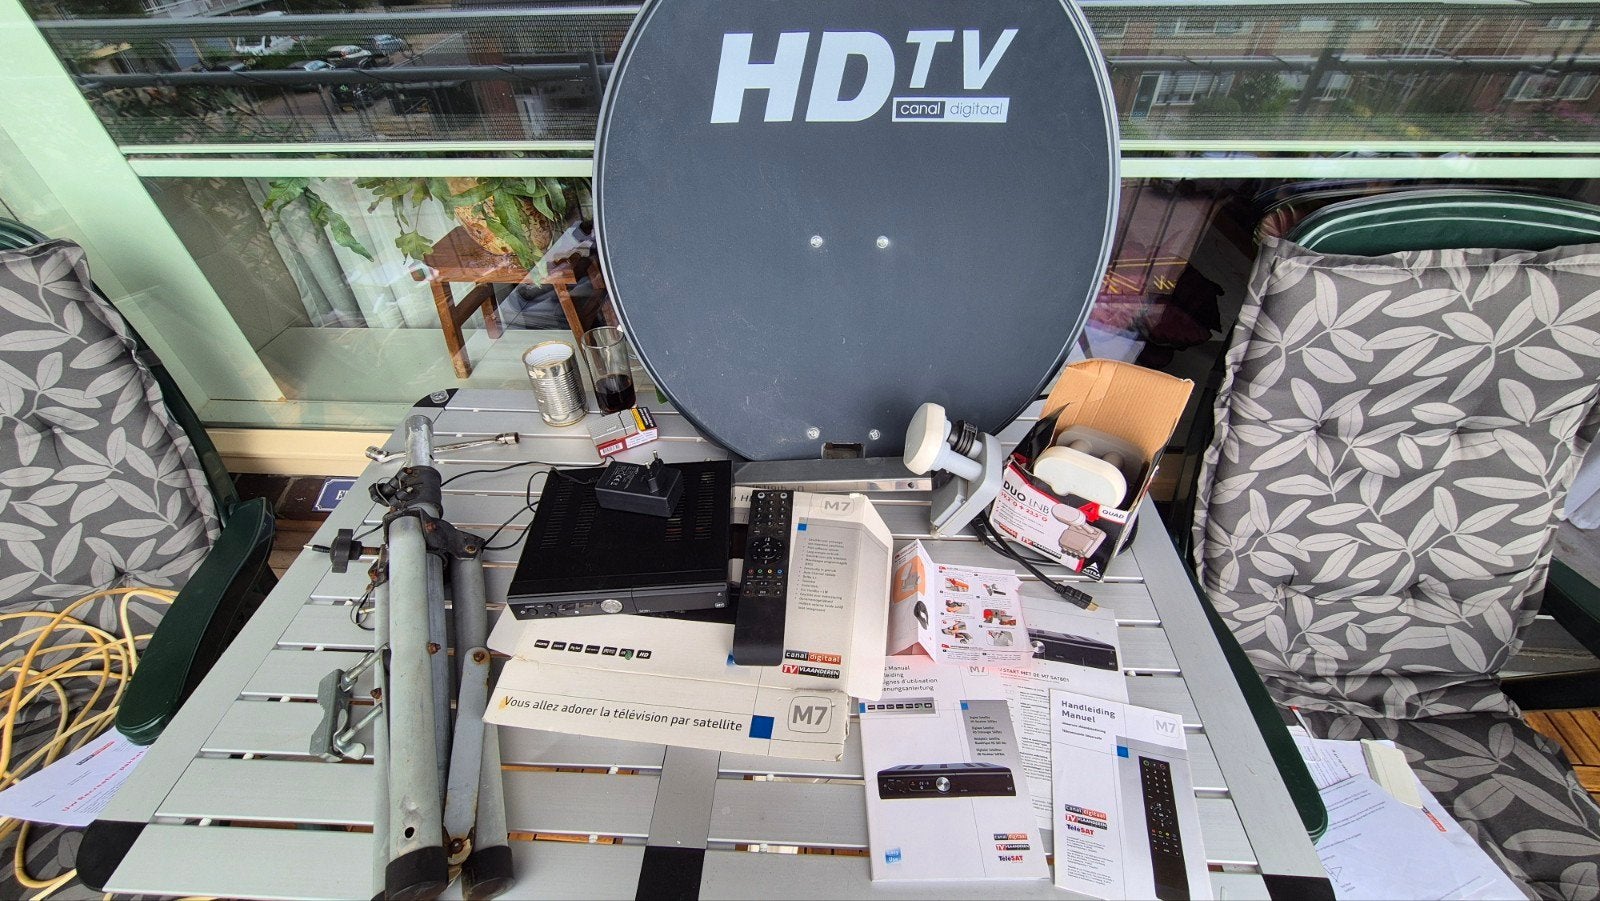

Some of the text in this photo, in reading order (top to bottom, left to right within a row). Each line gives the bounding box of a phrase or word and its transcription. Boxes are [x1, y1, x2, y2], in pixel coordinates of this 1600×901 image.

[900, 100, 1003, 118] canal digitaal
[1002, 480, 1050, 514] DUO LNB
[824, 501, 851, 512] M7
[1102, 509, 1125, 519] QUAD
[785, 651, 840, 663] canal digitaal
[783, 664, 798, 674] TV
[504, 696, 743, 731] Vous allez adorer la télévision par satellite
[793, 705, 828, 725] M7
[1061, 700, 1116, 719] Handleiding
[1062, 710, 1095, 723] Manuel
[1155, 719, 1176, 734] M7
